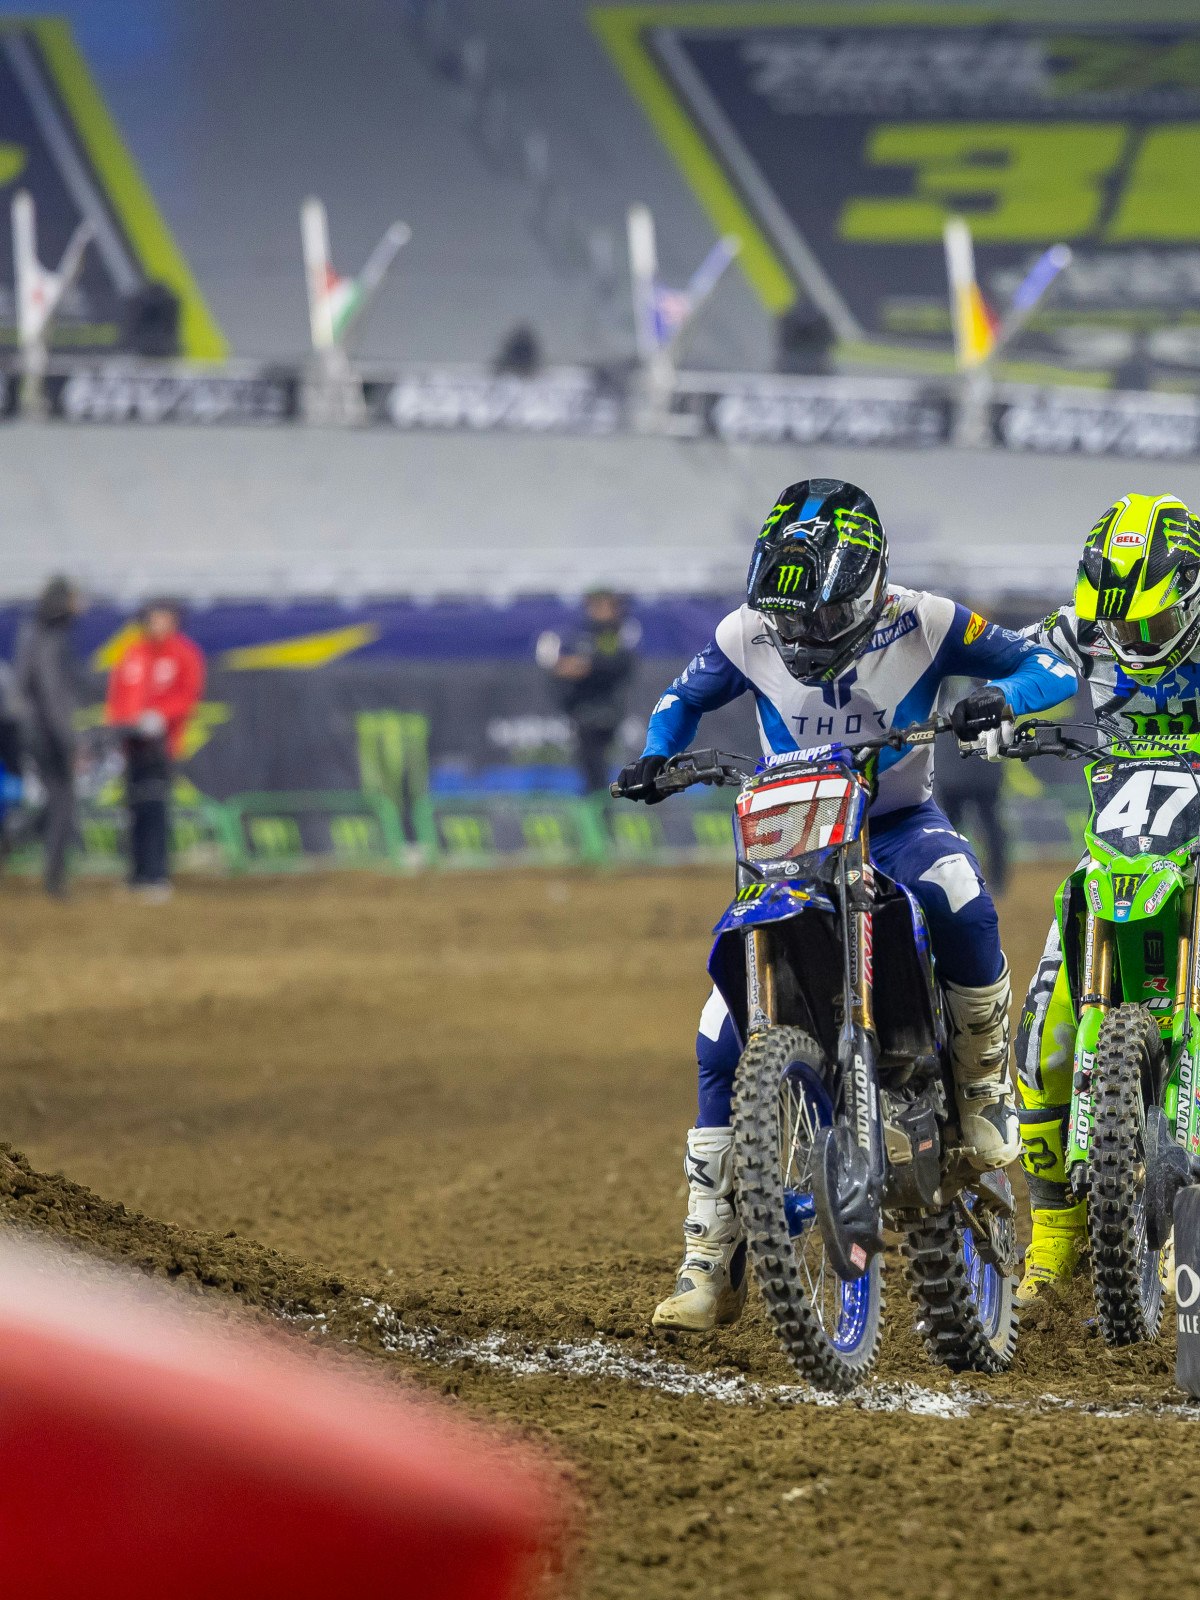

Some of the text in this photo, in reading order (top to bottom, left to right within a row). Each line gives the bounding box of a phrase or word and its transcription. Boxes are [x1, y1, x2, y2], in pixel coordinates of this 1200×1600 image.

[1116, 535, 1141, 544] BELL
[756, 596, 806, 609] MONSTER
[869, 614, 914, 648] YAMAHA
[762, 766, 818, 783] SUPERCROSS
[1118, 760, 1181, 769] SUPERCROSS
[854, 1054, 870, 1151] DUNLOP
[1075, 1050, 1094, 1150] DNLOP
[1175, 1049, 1194, 1150] DUNLOP
